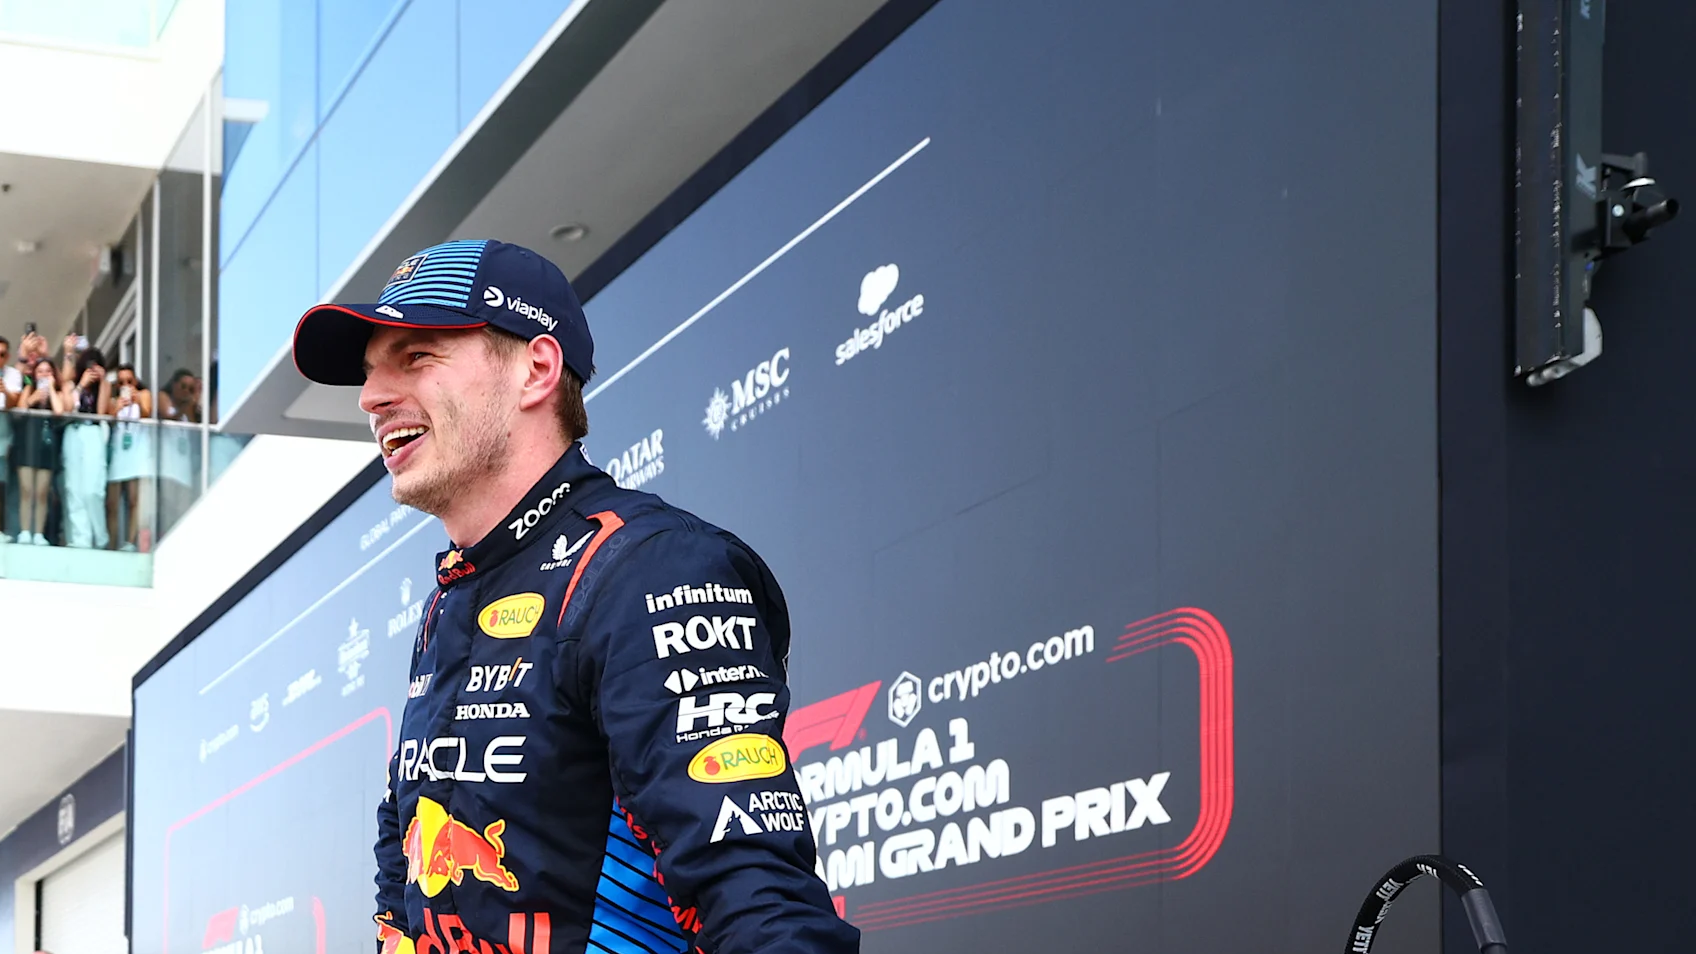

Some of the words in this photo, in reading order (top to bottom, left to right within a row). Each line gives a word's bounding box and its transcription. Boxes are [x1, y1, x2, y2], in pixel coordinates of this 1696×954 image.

[507, 297, 558, 332] viaplay
[835, 294, 924, 366] salesforce
[730, 347, 790, 415] MSC
[730, 386, 790, 432] CRUISES
[605, 428, 664, 482] QATAR
[645, 582, 753, 614] infinitum
[652, 615, 756, 659] ROKT
[928, 625, 1095, 704] crypto.com
[455, 703, 531, 720] HONDA
[676, 692, 779, 733] HRC
[676, 726, 732, 743] Honda
[398, 736, 527, 783] RACLE
[720, 747, 779, 770] RAUCH
[794, 728, 944, 805] RMULA
[949, 718, 975, 764] 1
[749, 790, 804, 812] ARCTIC
[761, 812, 805, 832] WOLF
[808, 759, 1011, 848] YPTO.COM
[879, 807, 1036, 879] GRAND
[1041, 771, 1172, 848] PRIX
[1352, 926, 1374, 954] YETI
